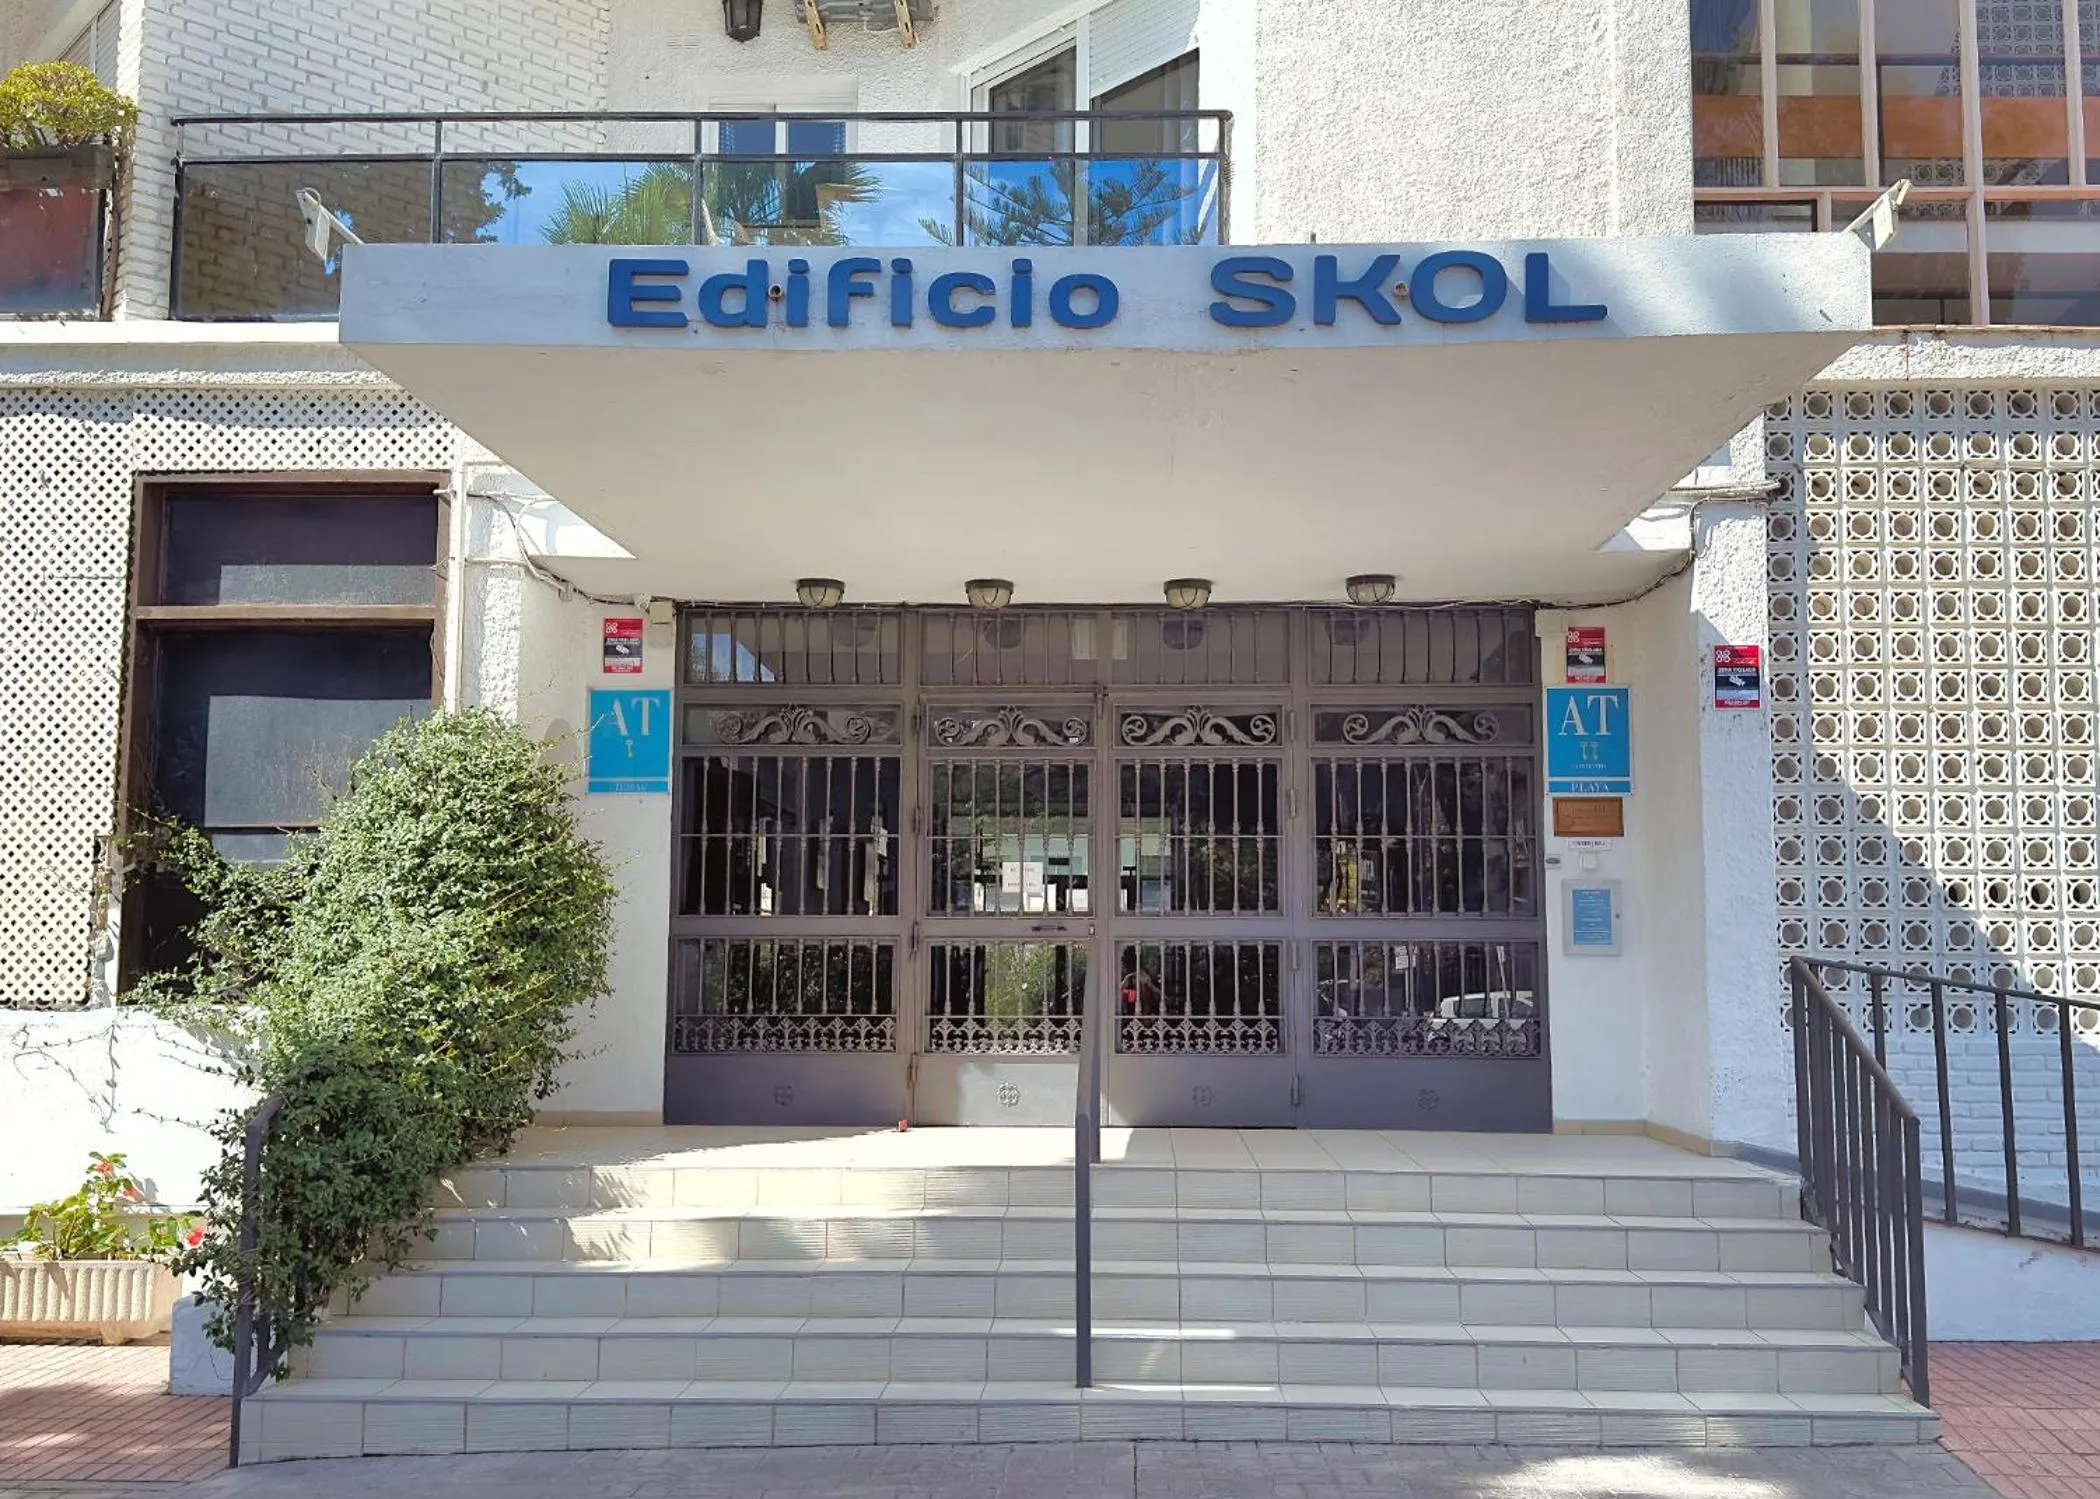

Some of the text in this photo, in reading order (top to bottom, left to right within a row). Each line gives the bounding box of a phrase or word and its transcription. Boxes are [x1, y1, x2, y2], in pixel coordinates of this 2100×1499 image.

[607, 250, 1608, 329] Edificio SKOL
[605, 697, 660, 736] AT
[1558, 694, 1619, 736] AT
[1571, 782, 1609, 793] PLAYA
